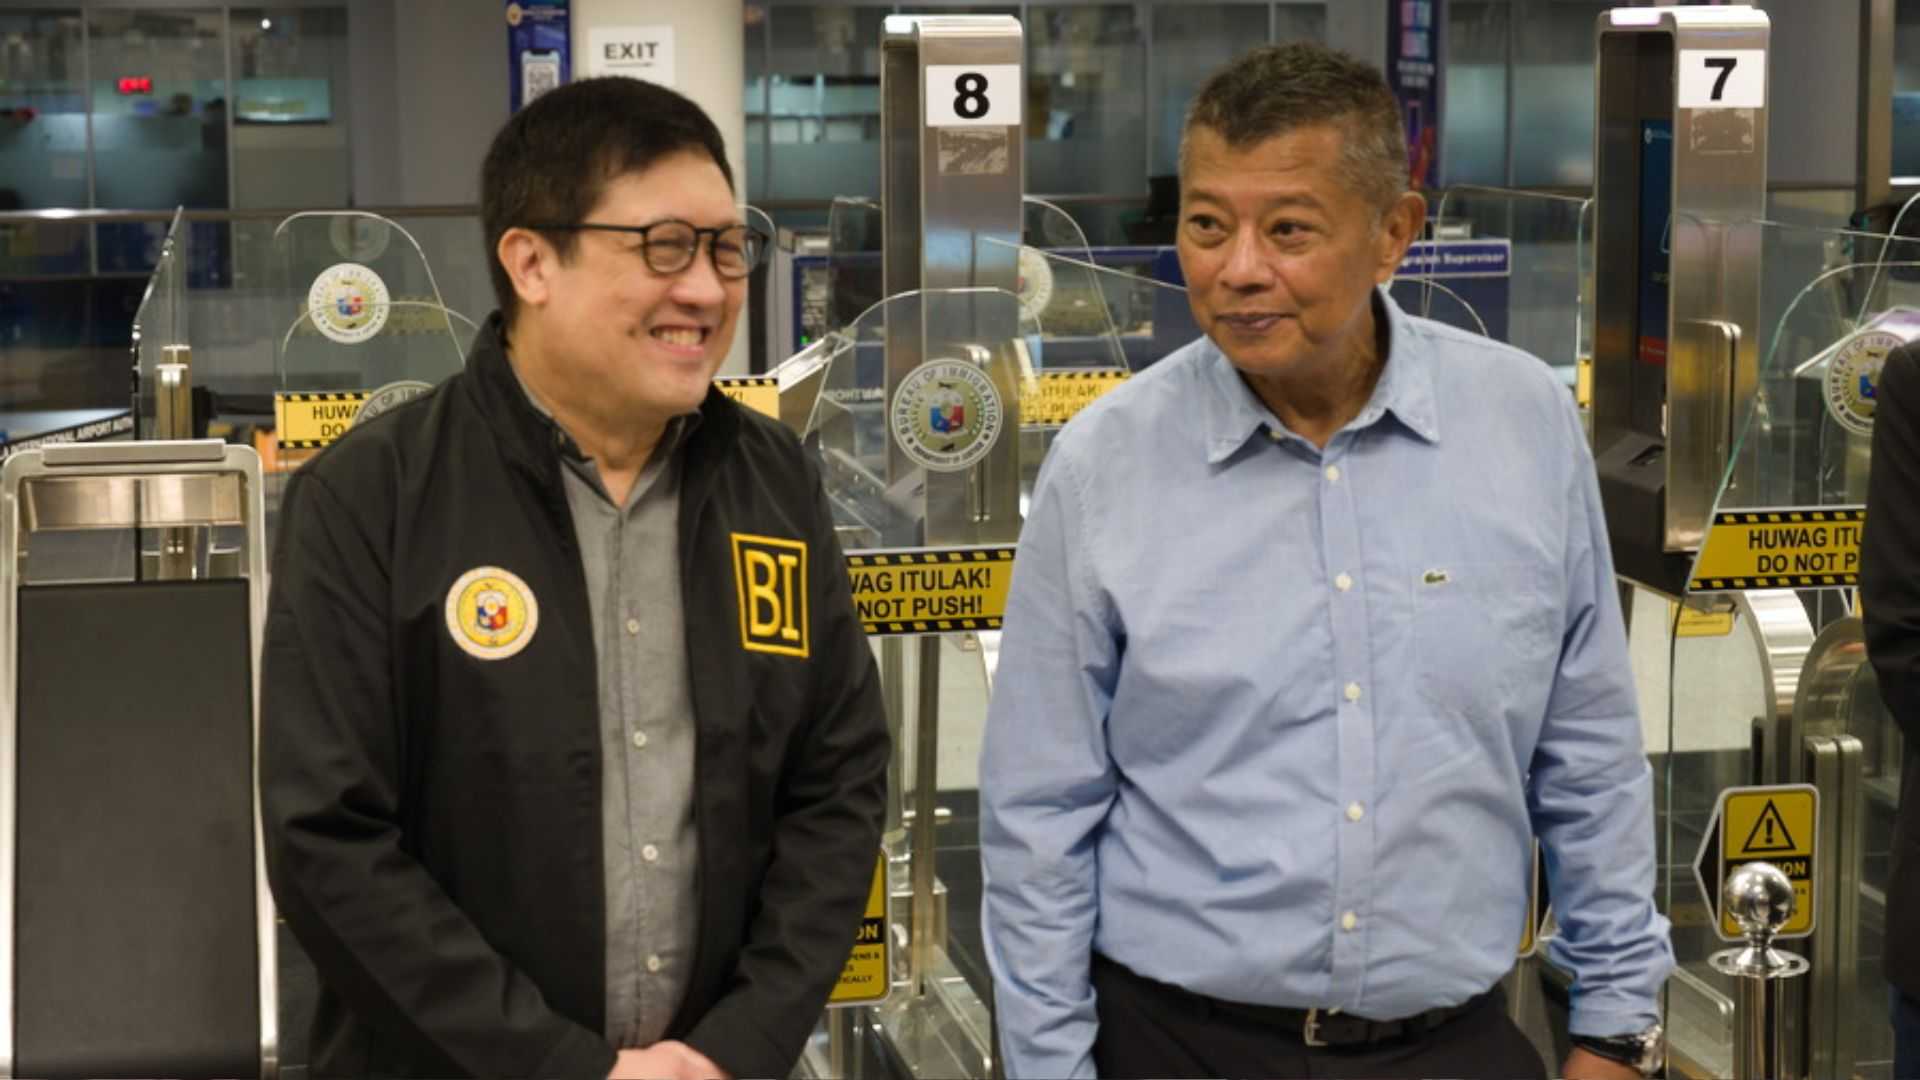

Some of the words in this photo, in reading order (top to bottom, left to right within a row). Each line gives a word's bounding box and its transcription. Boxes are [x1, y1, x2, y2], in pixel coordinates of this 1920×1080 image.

[604, 41, 659, 60] EXIT
[1703, 57, 1738, 101] 7
[953, 72, 990, 119] 8
[1443, 252, 1505, 265] Supervisor
[1748, 526, 1828, 550] HUWAG
[1757, 554, 1788, 573] DO
[1794, 552, 1838, 572] NOT
[900, 567, 992, 592] ITULAK!
[744, 548, 800, 641] BI
[856, 598, 906, 619] NOT
[912, 595, 983, 617] PUSH!
